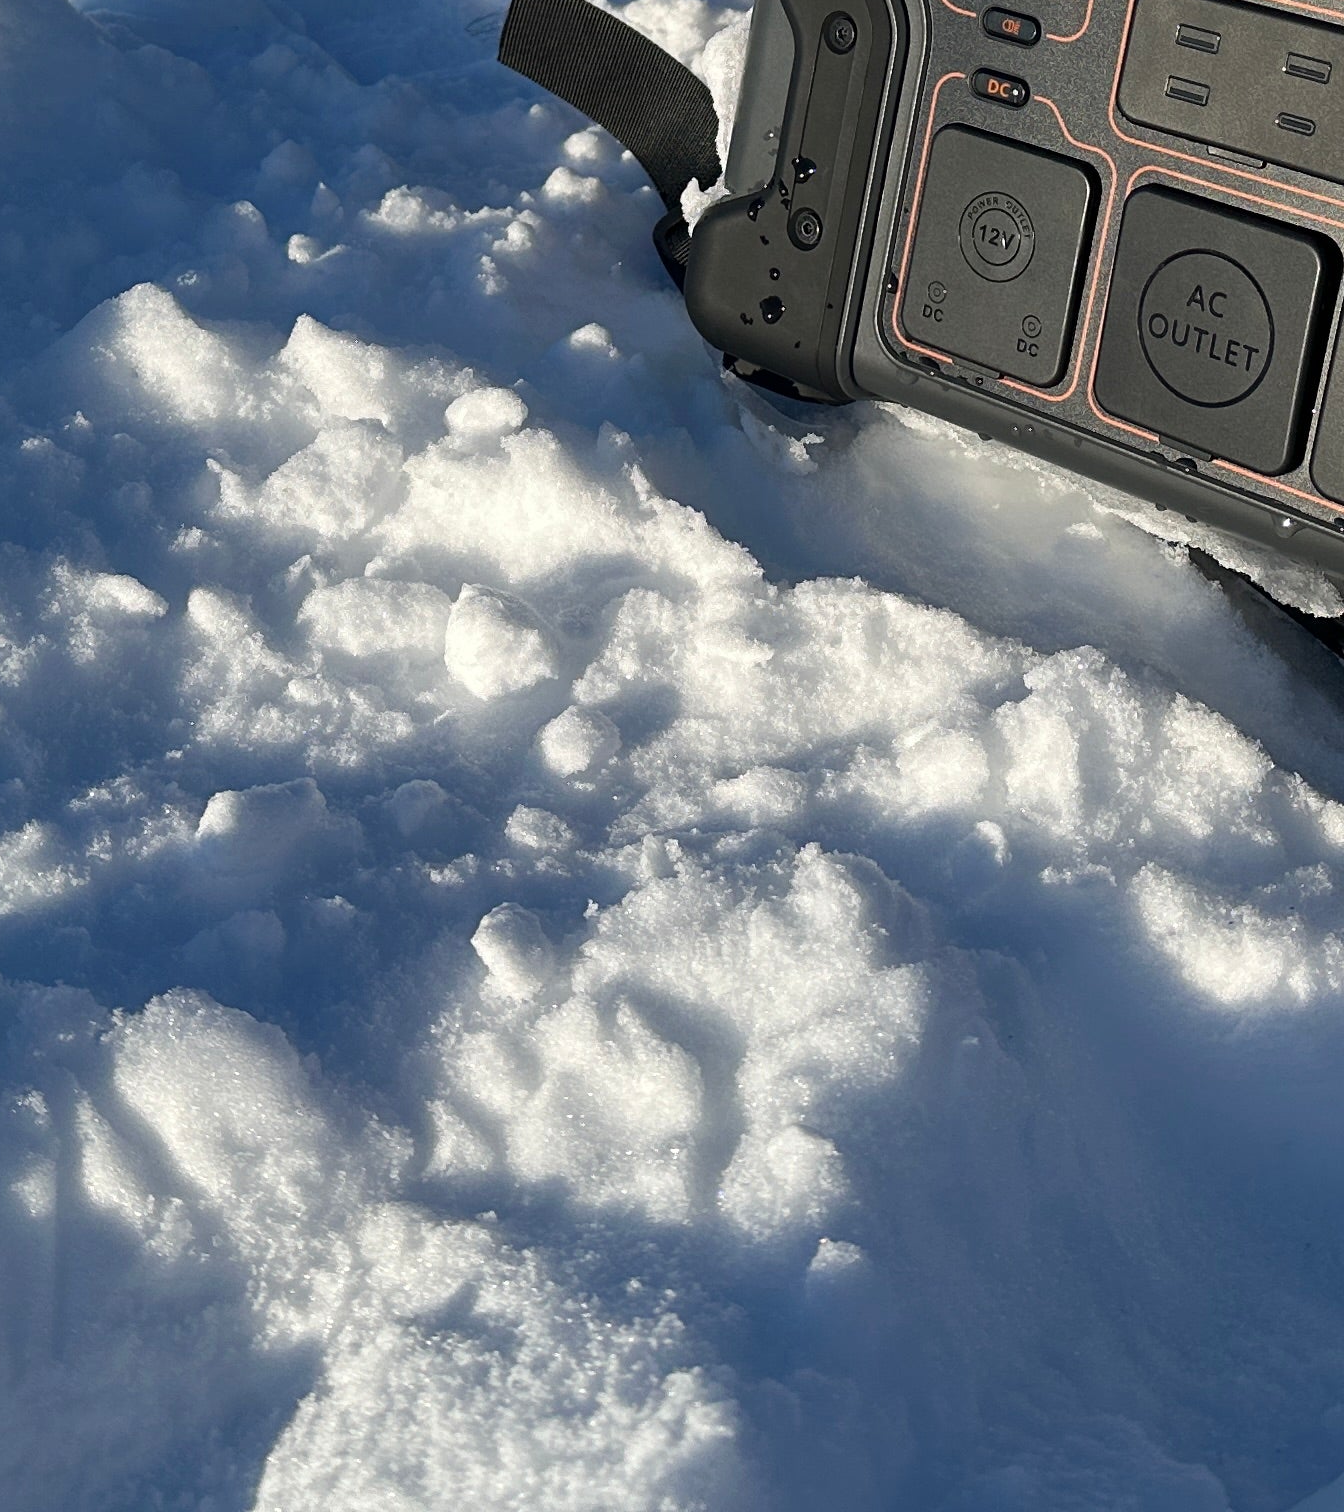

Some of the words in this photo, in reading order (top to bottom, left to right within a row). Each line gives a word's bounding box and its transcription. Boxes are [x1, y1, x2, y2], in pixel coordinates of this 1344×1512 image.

[987, 78, 1012, 98] DC
[967, 196, 999, 220] POWER
[1005, 200, 1031, 239] OUTLET
[979, 224, 1016, 250] 12V
[922, 303, 944, 323] DC
[1186, 284, 1228, 319] AC
[1016, 338, 1039, 358] DC
[1148, 312, 1260, 372] OUTLET
